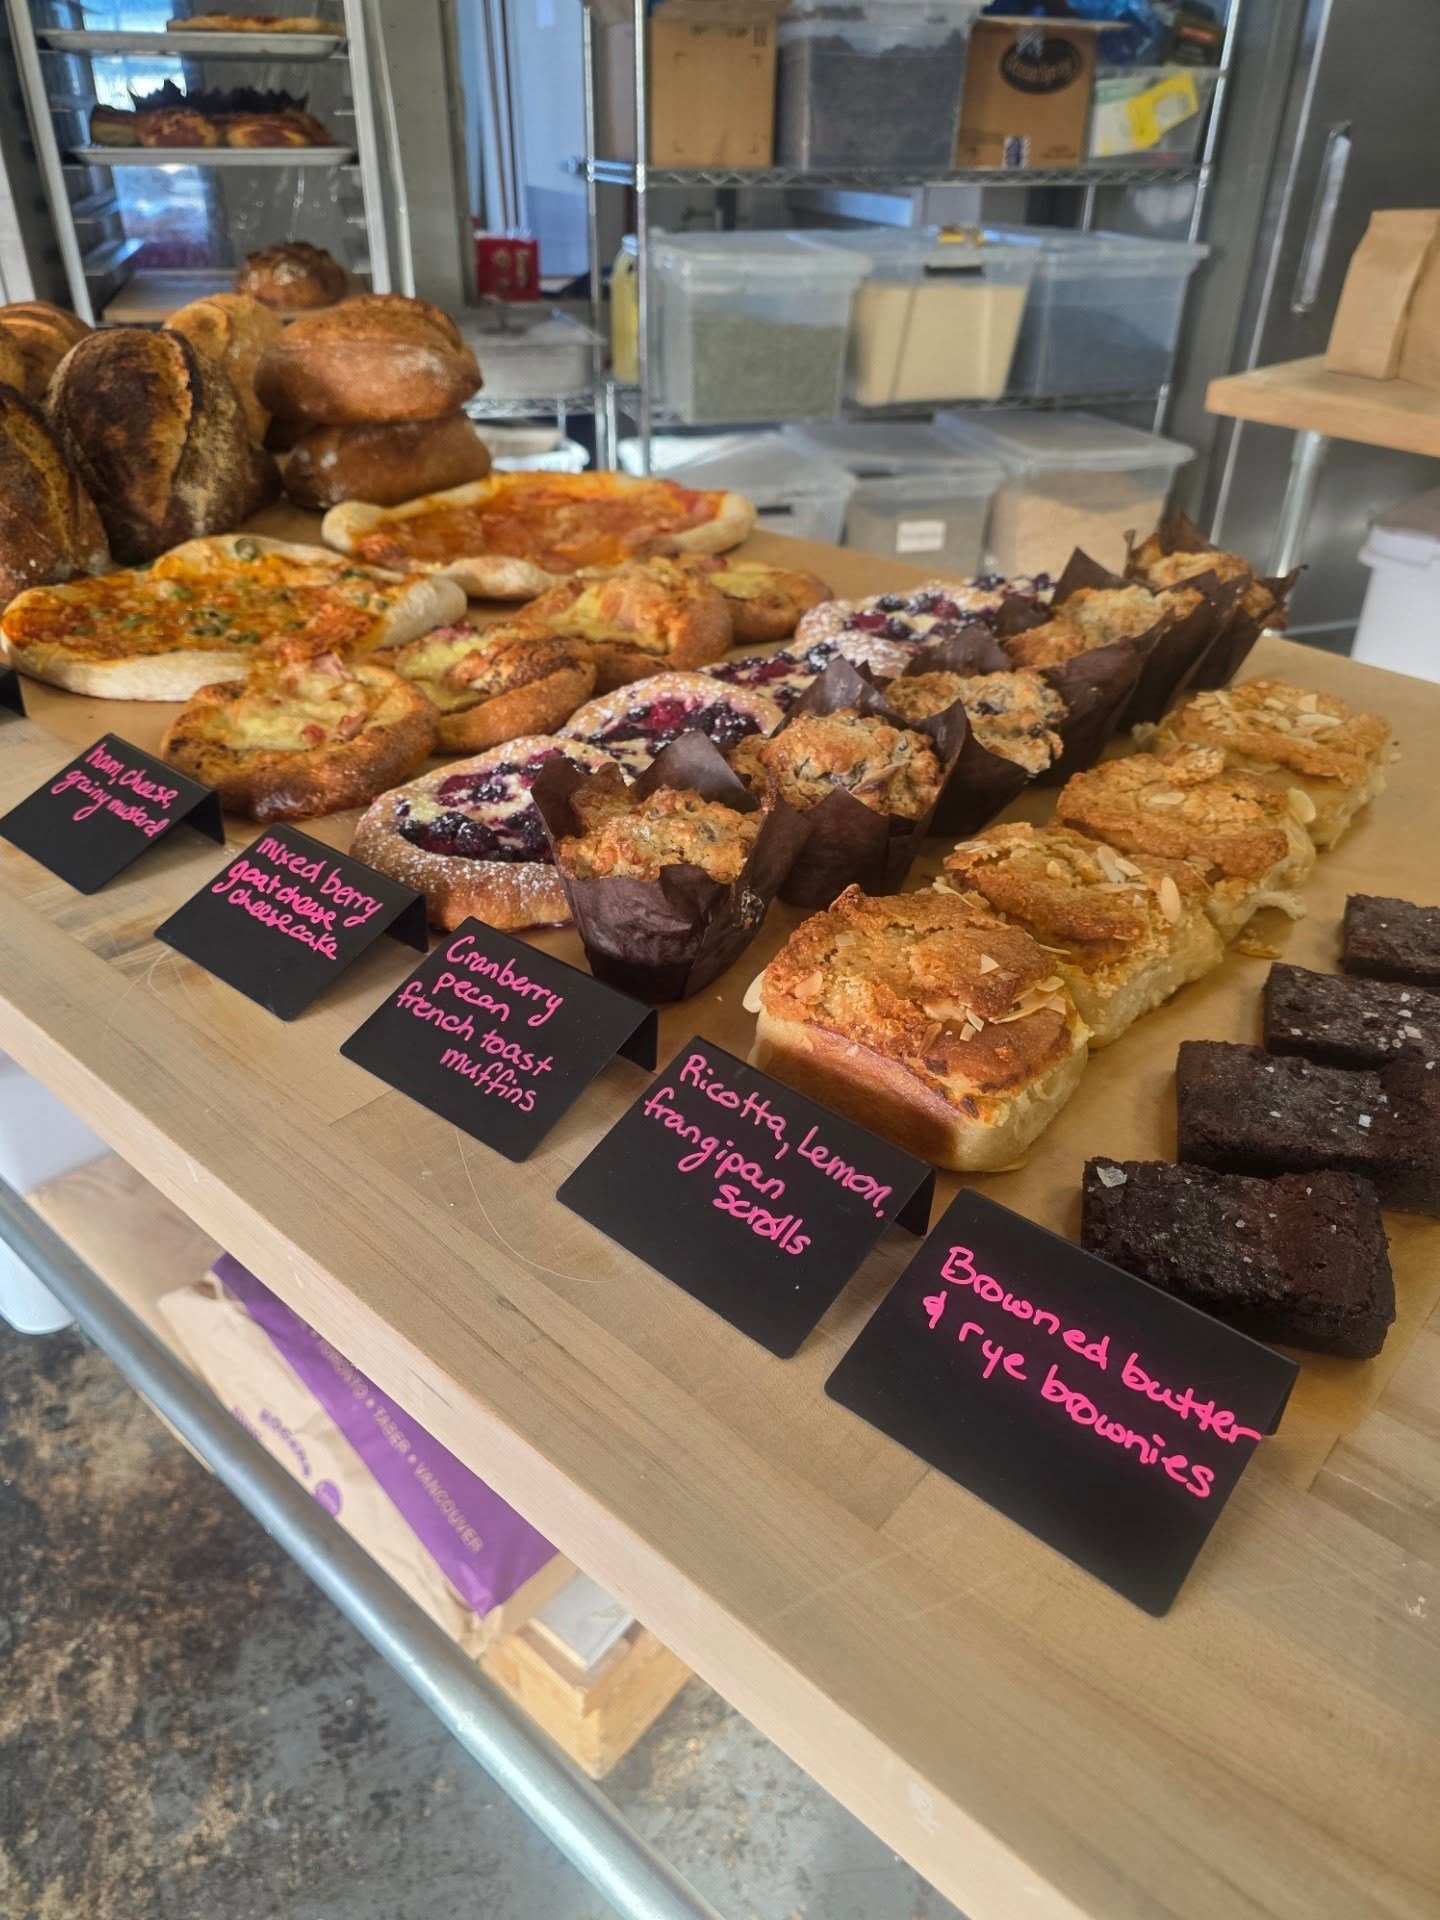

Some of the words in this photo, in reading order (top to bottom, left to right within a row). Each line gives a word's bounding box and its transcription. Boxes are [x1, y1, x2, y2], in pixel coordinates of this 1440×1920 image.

[51, 770, 113, 821] grainy
[107, 799, 170, 837] mustard
[85, 743, 125, 786] ham,
[211, 860, 281, 894] goat
[275, 886, 337, 931] cheese
[256, 837, 327, 883] mixed
[320, 868, 384, 927] berry
[432, 972, 511, 1022] pecan
[446, 935, 564, 1027] Cranberry
[397, 981, 475, 1041] french
[481, 1030, 553, 1077] toast
[440, 1048, 537, 1113] muffins
[679, 1054, 790, 1160] Ricotta,
[643, 1087, 786, 1200] frangipan
[940, 1246, 1110, 1370] Browned
[1121, 1352, 1262, 1443] butter
[959, 1321, 1027, 1380] rye
[1041, 1364, 1215, 1498] brownies
[413, 1461, 484, 1553] VANCOUVER
